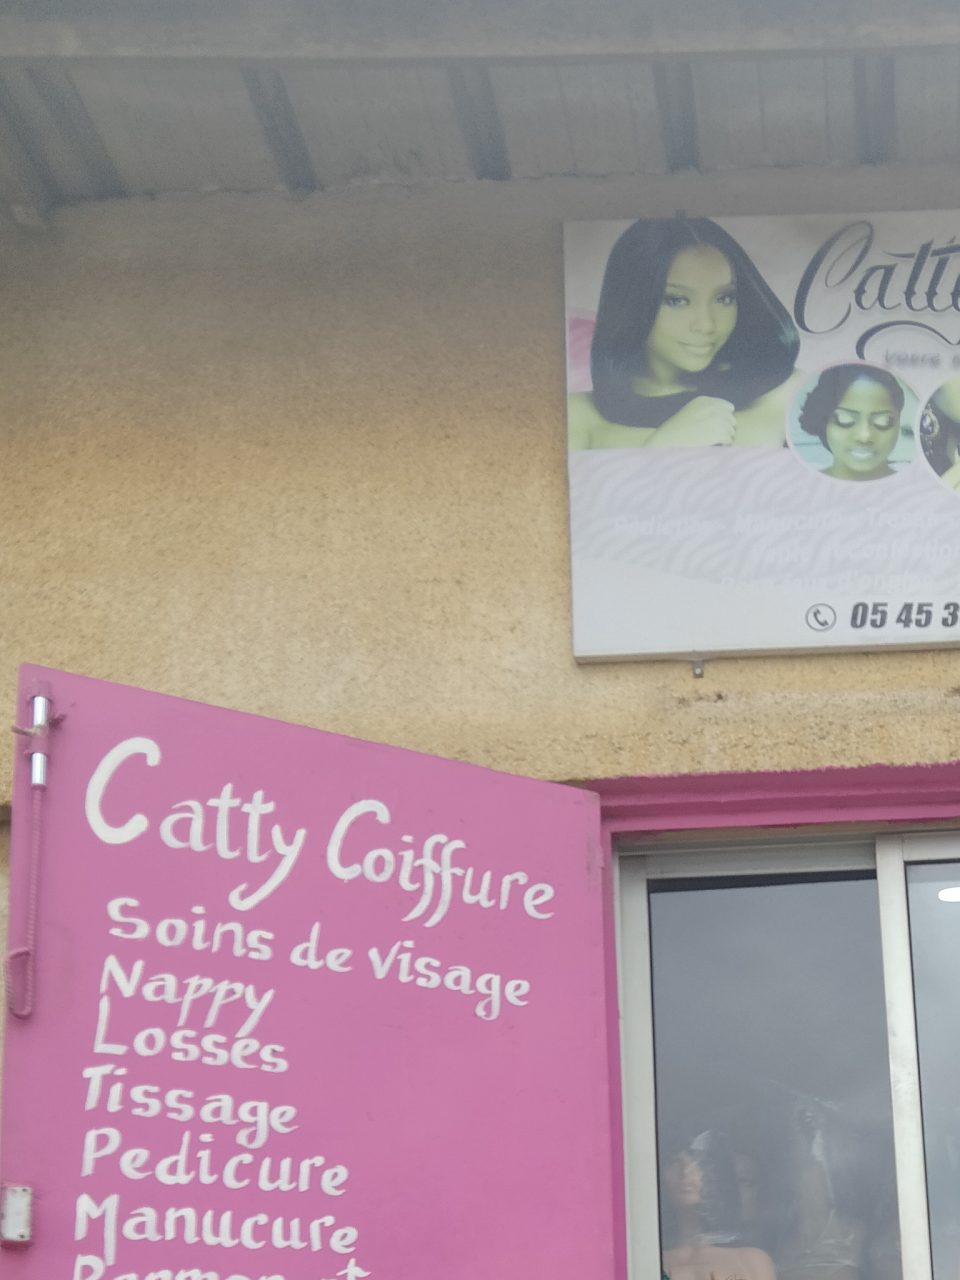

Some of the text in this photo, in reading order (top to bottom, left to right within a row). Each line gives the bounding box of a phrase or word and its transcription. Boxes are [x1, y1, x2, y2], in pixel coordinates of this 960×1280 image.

[850, 602, 888, 629] 05
[896, 602, 933, 628] 45
[85, 736, 556, 928] Catty Coiffure
[107, 897, 274, 960] Soins
[290, 922, 352, 973] de
[93, 995, 289, 1074] Losses
[100, 954, 275, 1038] Nappy
[82, 1063, 299, 1149] Tissage
[80, 1127, 349, 1197] Pedicure
[73, 1193, 359, 1266] Manucure
